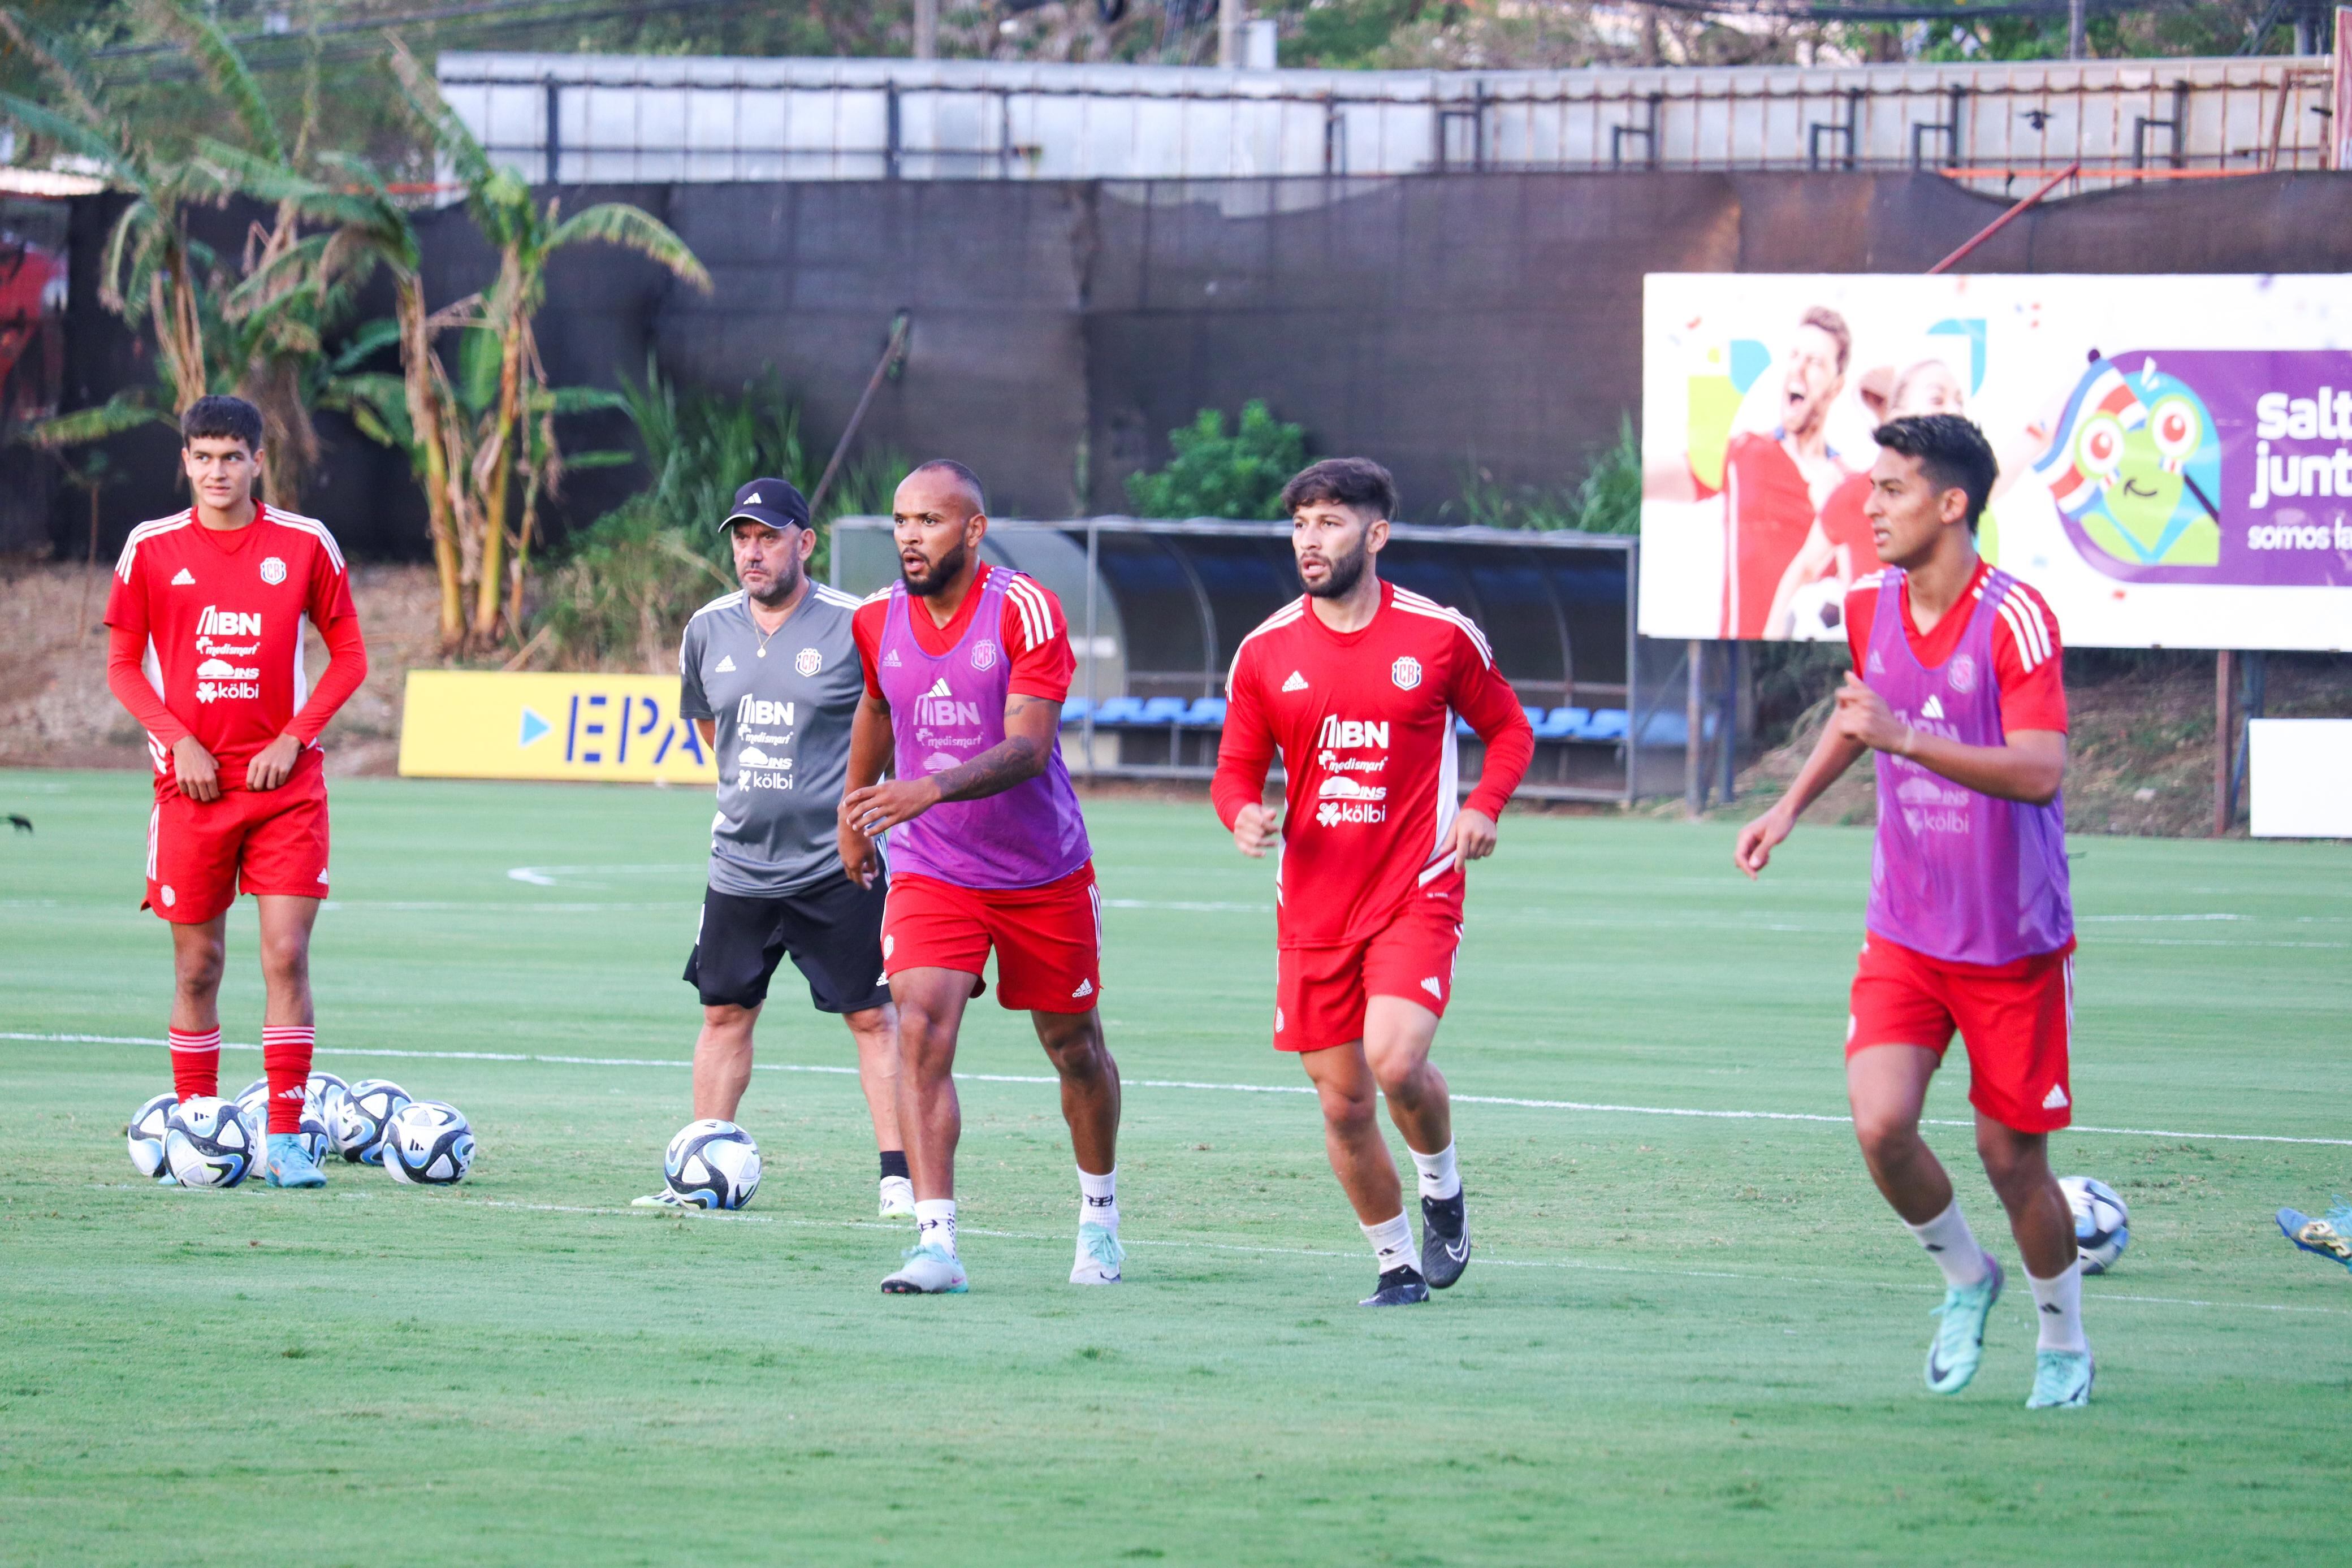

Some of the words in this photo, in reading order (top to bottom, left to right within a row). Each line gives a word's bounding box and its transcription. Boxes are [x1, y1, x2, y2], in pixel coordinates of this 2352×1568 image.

[2256, 385, 2352, 440] Salt
[2249, 440, 2352, 509] junt
[2247, 525, 2331, 551] somos
[218, 612, 261, 636] BN
[205, 643, 258, 657] medismart
[802, 654, 816, 670] CR
[234, 668, 260, 677] INS
[1399, 664, 1415, 684] CR
[218, 682, 259, 699] kölbi
[1282, 681, 1308, 692] adidas
[755, 700, 794, 726] BN
[936, 700, 981, 726] BN
[567, 695, 704, 765] EPA
[745, 731, 790, 746] medismart
[1342, 721, 1389, 749] BN
[928, 734, 982, 748] medismart
[768, 757, 793, 767] INS
[1329, 757, 1385, 773] medismart
[754, 770, 793, 790] kölbi
[1360, 786, 1386, 799] INS
[1342, 802, 1385, 823] kölbi
